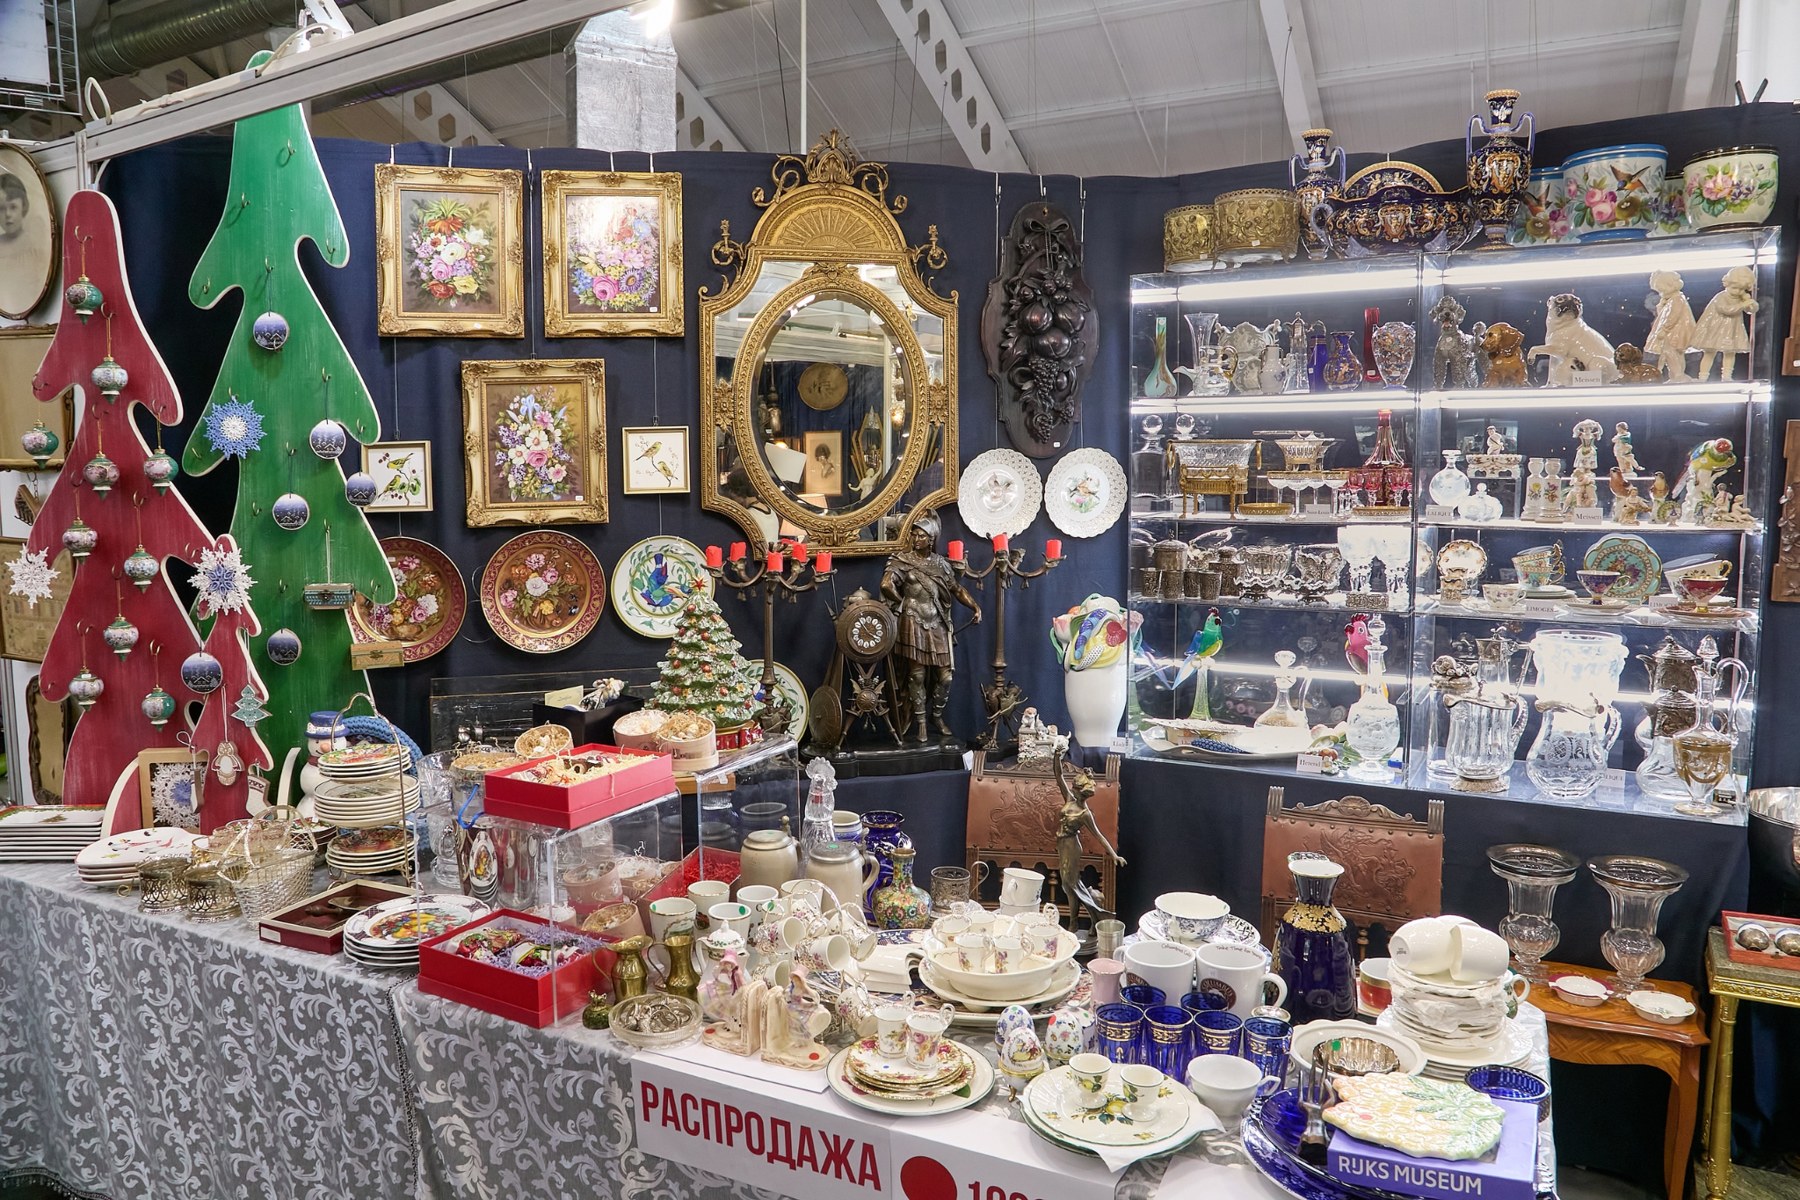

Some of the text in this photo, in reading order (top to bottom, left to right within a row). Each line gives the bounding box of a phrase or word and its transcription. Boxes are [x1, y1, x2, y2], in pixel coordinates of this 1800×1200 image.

[1300, 759, 1321, 767] Herend
[641, 1080, 882, 1192] РАСПРОДАЖА
[1394, 1164, 1483, 1196] MUSEUM
